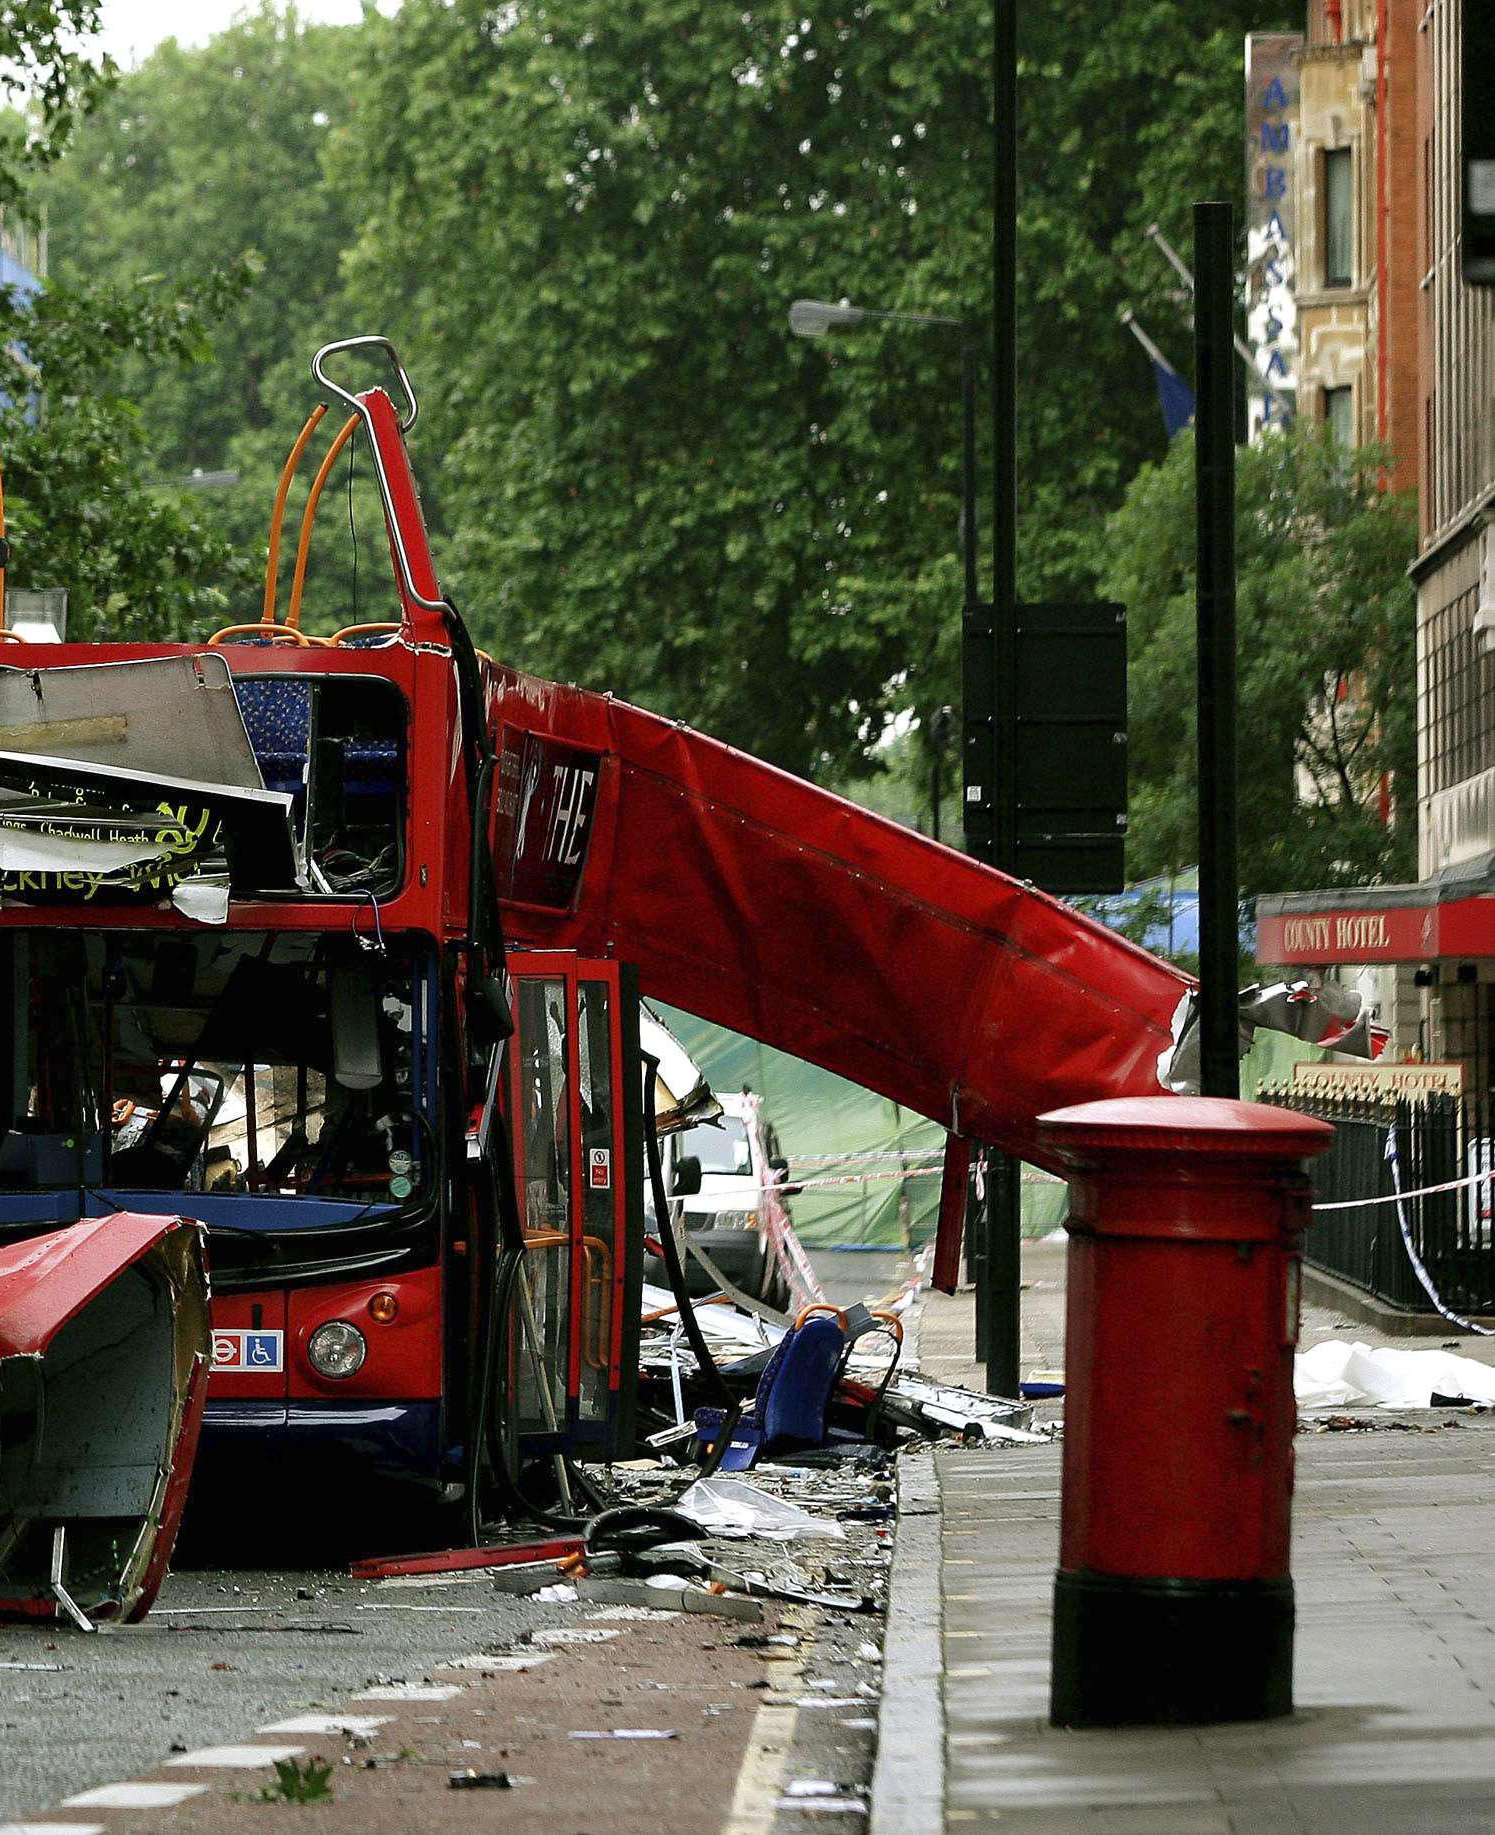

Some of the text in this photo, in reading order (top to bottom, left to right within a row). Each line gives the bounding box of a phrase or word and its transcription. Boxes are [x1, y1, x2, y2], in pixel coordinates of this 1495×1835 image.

[542, 764, 595, 865] THE
[1284, 914, 1391, 952] COUNTY HOTEL
[1303, 1072, 1449, 1091] COUNTY HOTEL
